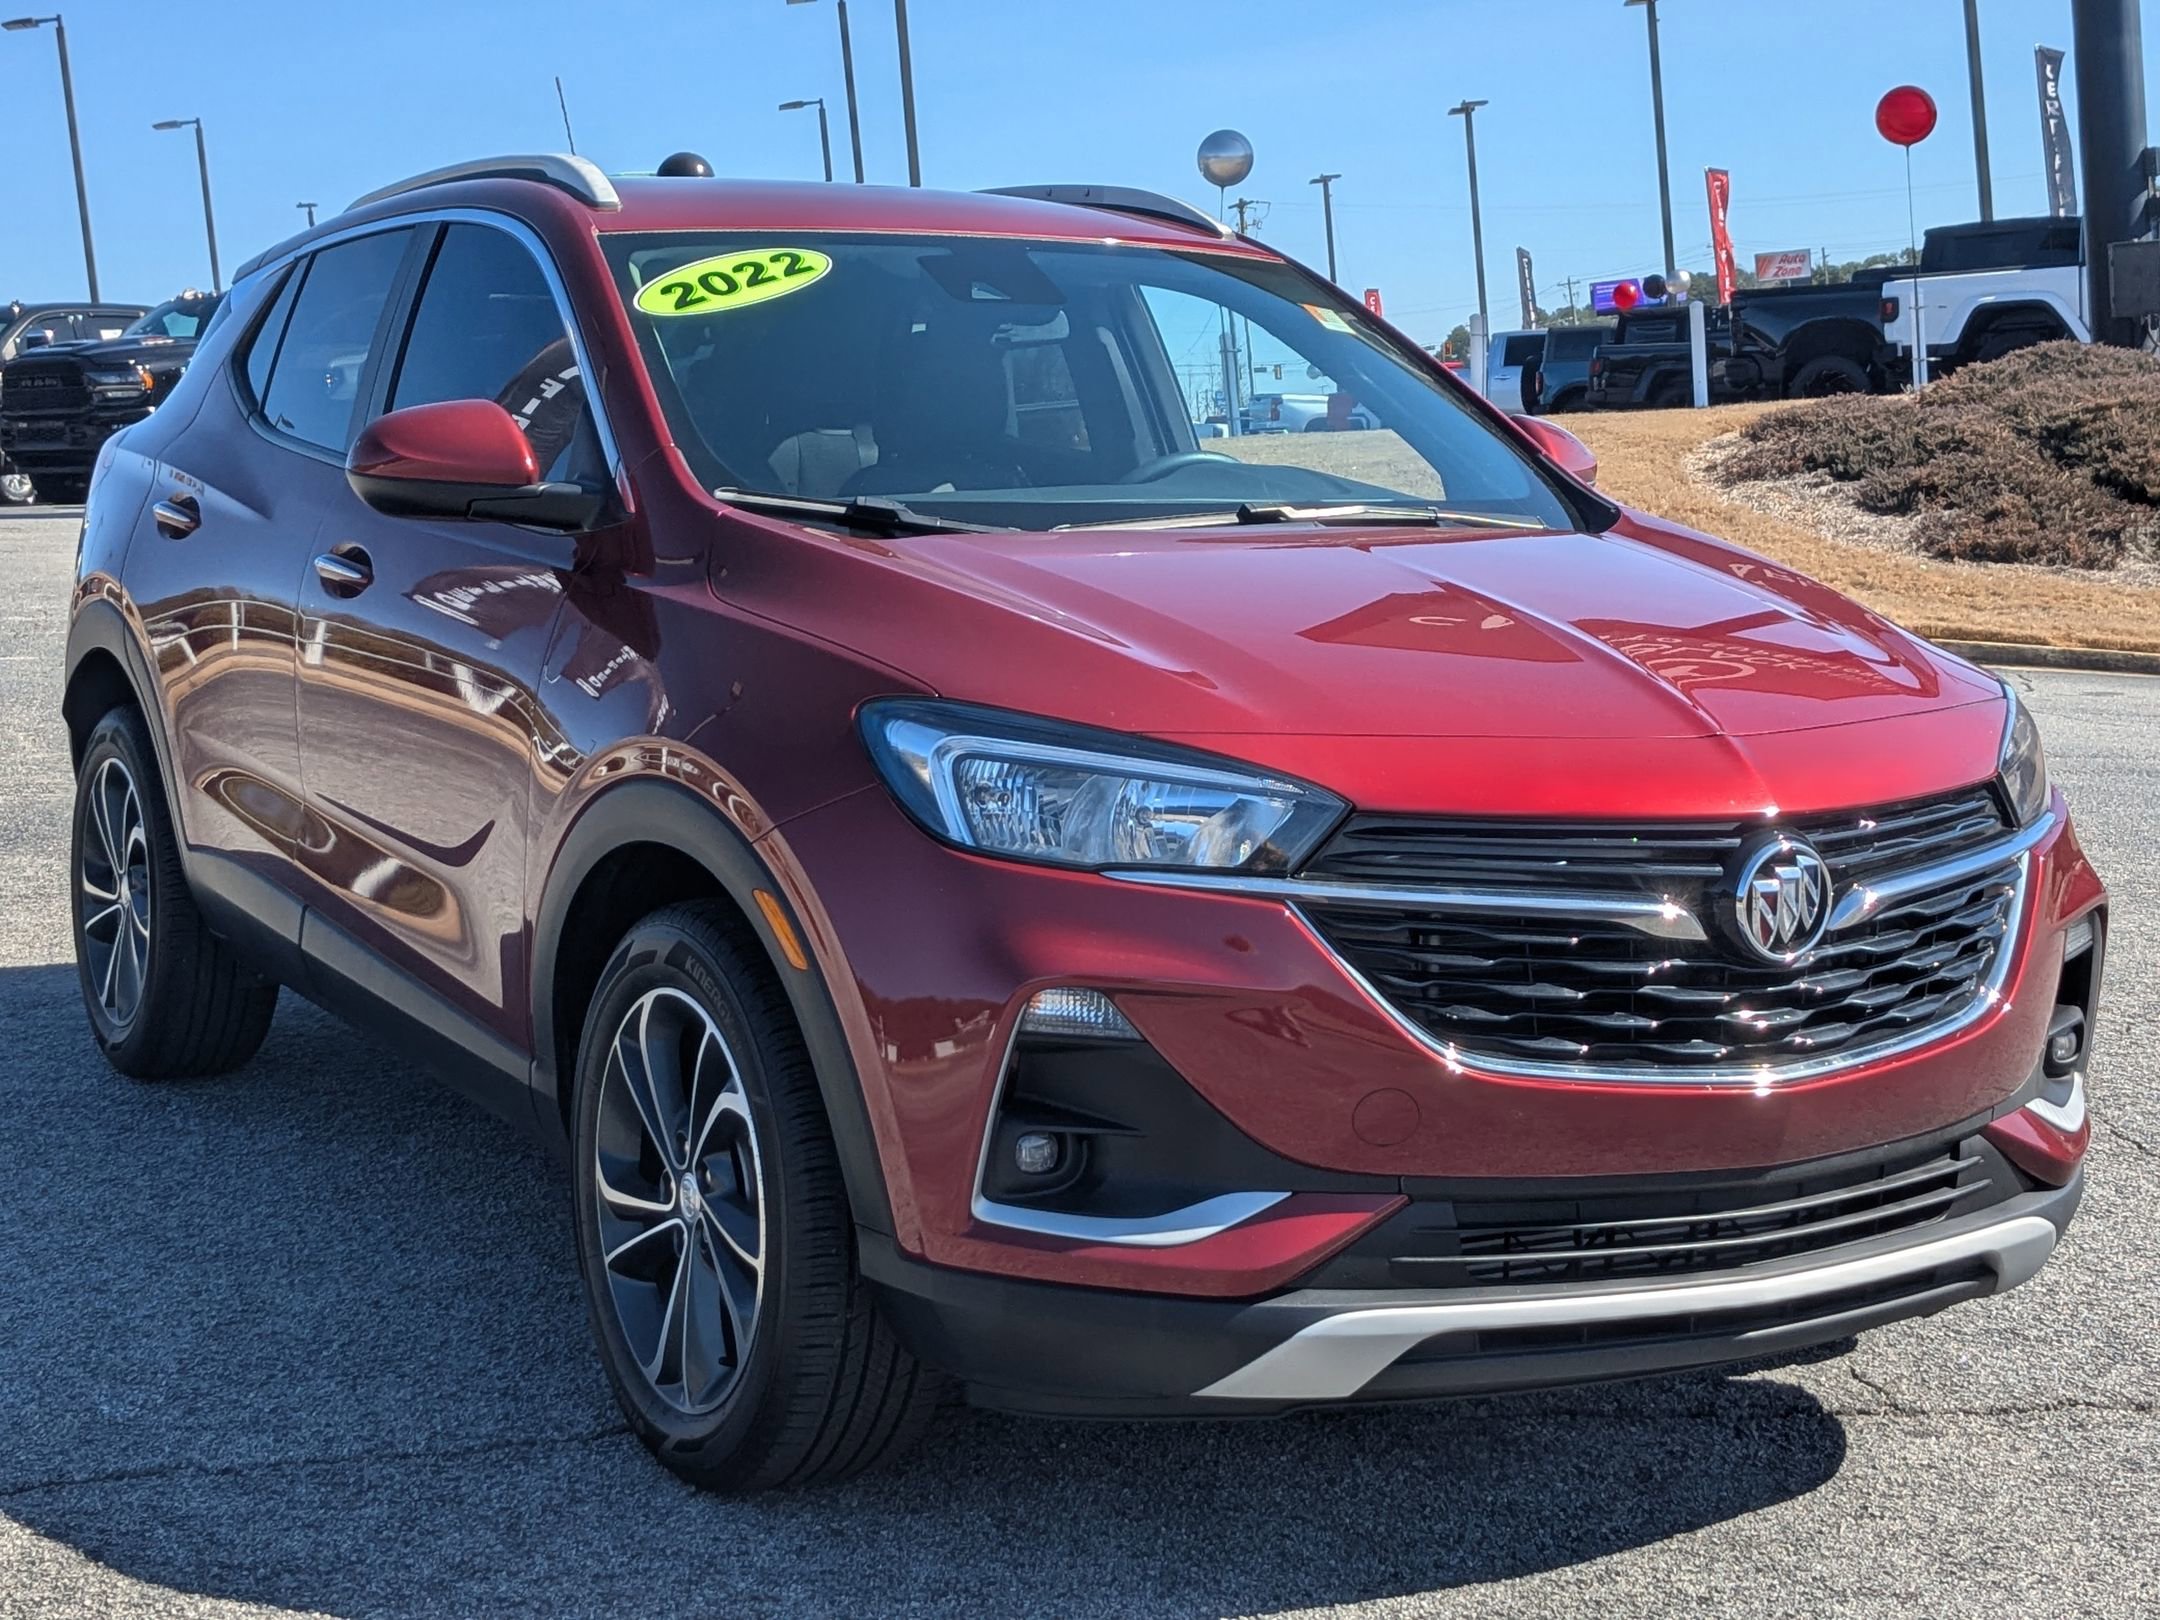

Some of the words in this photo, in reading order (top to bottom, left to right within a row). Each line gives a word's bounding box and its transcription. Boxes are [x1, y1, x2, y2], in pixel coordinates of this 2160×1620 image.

[1778, 253, 1806, 264] Auto
[1772, 266, 1802, 277] Zone
[660, 252, 816, 311] 2022
